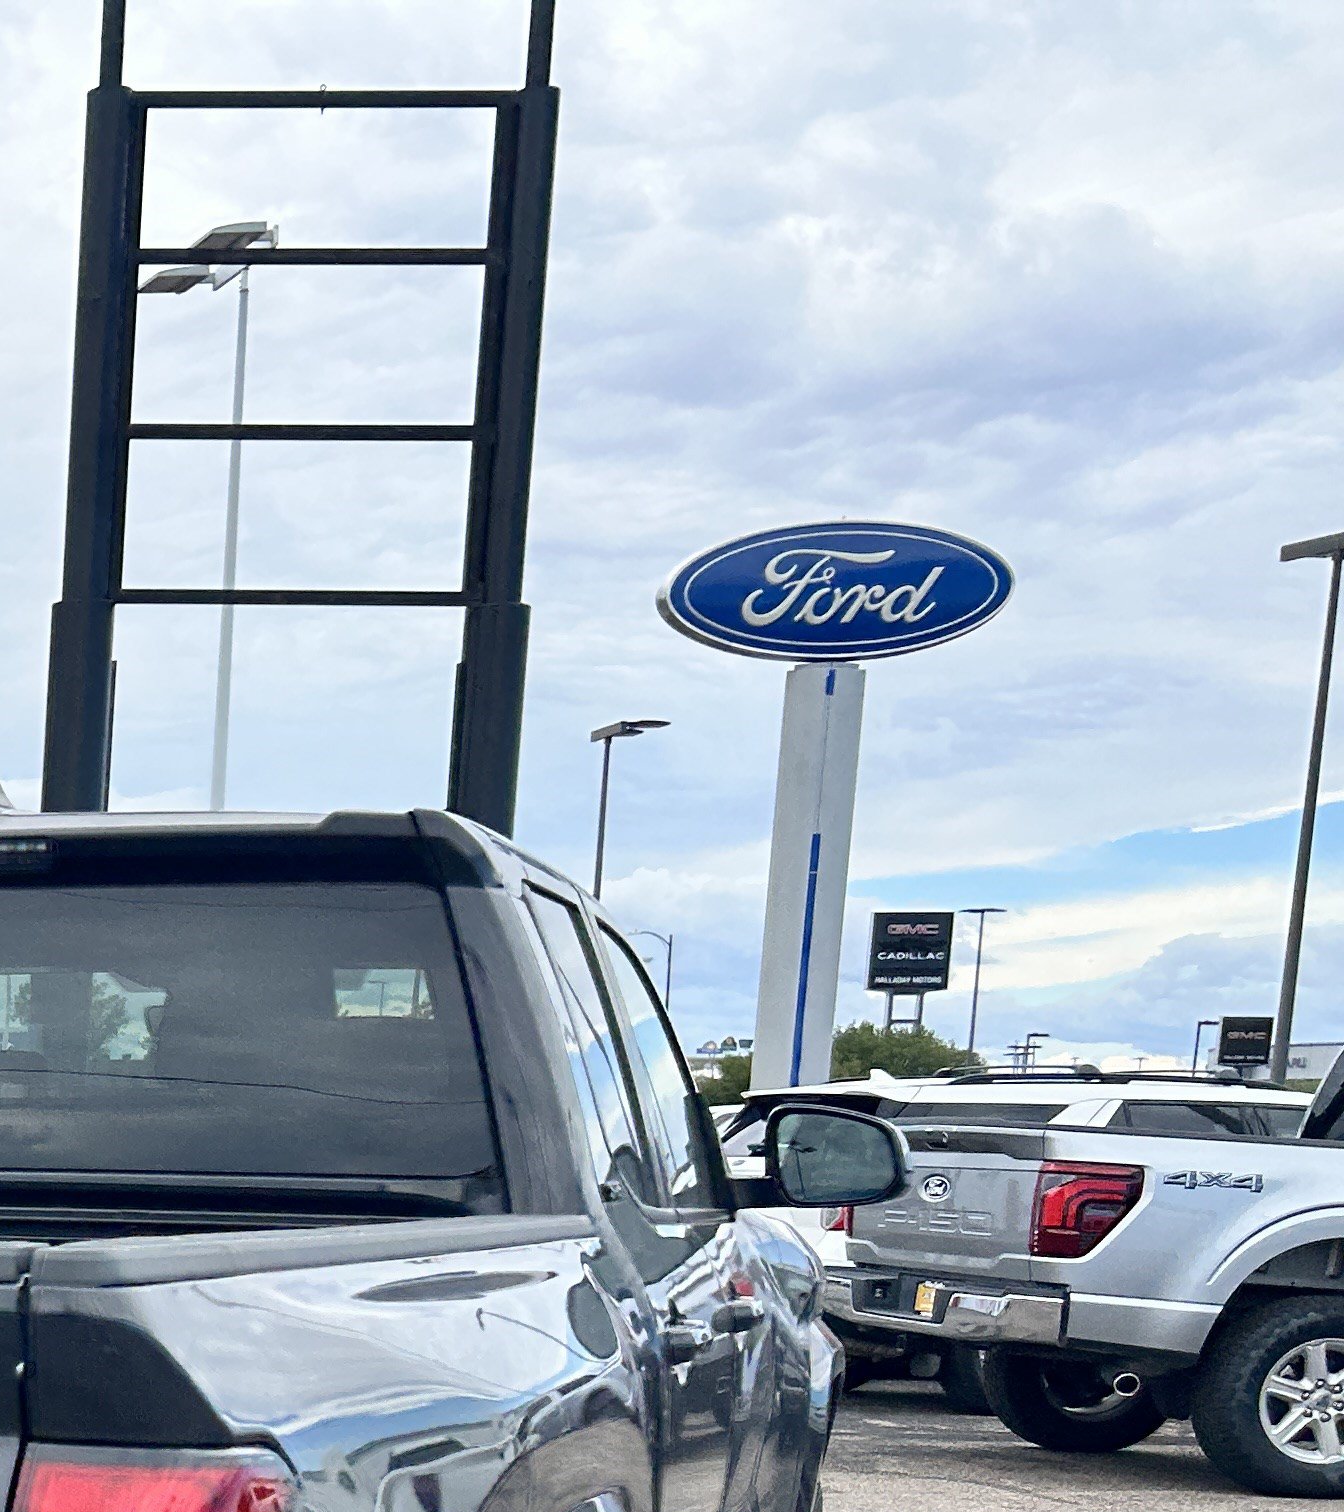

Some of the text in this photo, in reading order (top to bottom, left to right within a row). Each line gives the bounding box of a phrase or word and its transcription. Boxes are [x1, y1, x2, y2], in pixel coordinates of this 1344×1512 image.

[741, 548, 946, 627] Ford
[887, 923, 940, 935] GMC
[876, 951, 945, 961] CADILLAC
[876, 1208, 993, 1238] F-150
